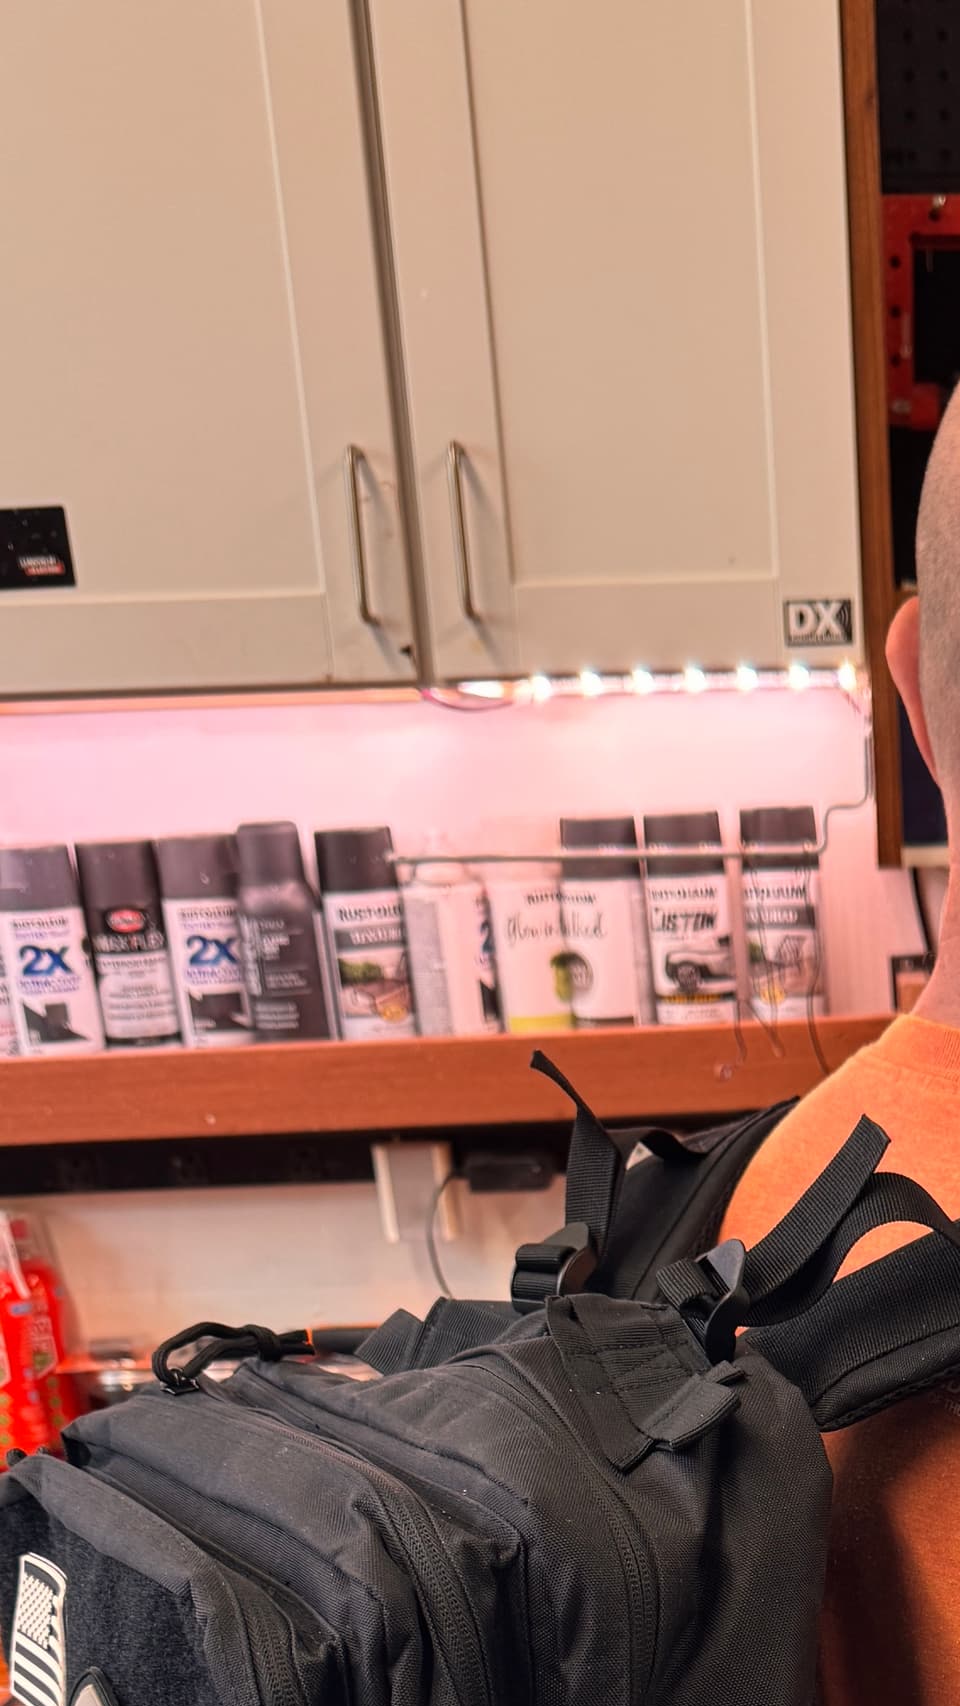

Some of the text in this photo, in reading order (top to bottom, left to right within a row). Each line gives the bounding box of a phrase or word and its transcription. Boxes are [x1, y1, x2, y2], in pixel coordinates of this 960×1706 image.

[789, 602, 842, 636] DX
[19, 945, 73, 976] 2X
[187, 935, 238, 965] 2X
